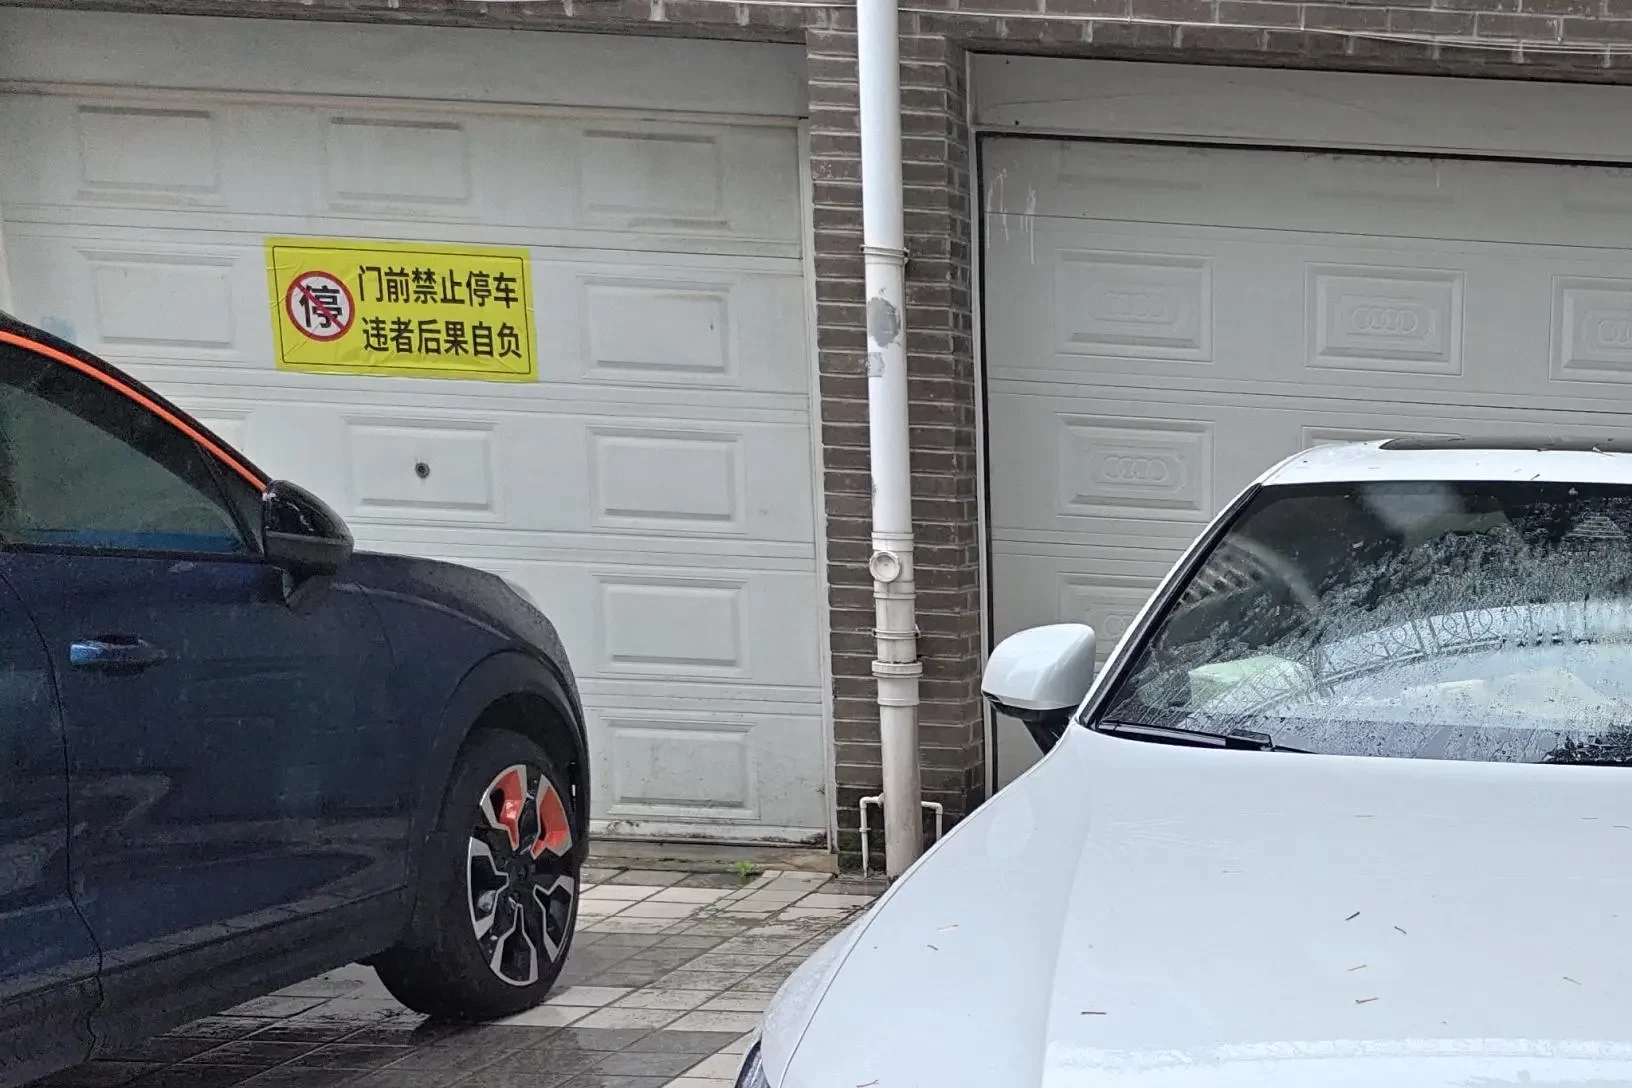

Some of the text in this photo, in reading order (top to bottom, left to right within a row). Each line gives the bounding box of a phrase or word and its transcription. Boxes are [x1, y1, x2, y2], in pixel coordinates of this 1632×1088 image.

[299, 285, 343, 328] 停
[358, 265, 519, 309] 门前禁止停车
[362, 316, 522, 359] 违者后果自负
